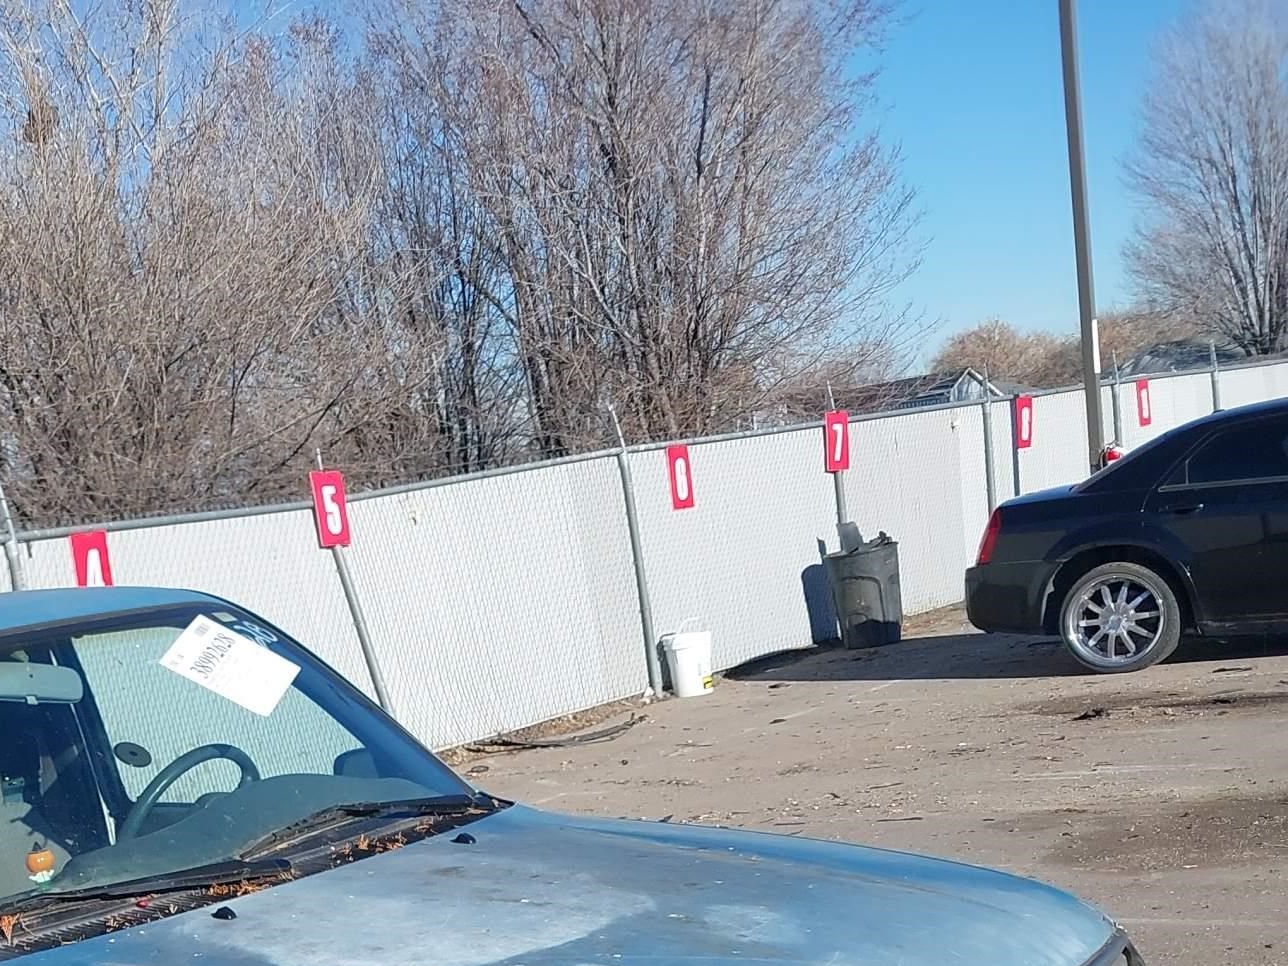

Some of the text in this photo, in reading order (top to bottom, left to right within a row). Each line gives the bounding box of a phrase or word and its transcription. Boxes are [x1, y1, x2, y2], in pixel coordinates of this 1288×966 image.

[832, 423, 843, 461] 7
[321, 485, 343, 534] 5
[189, 632, 237, 679] 38992628
